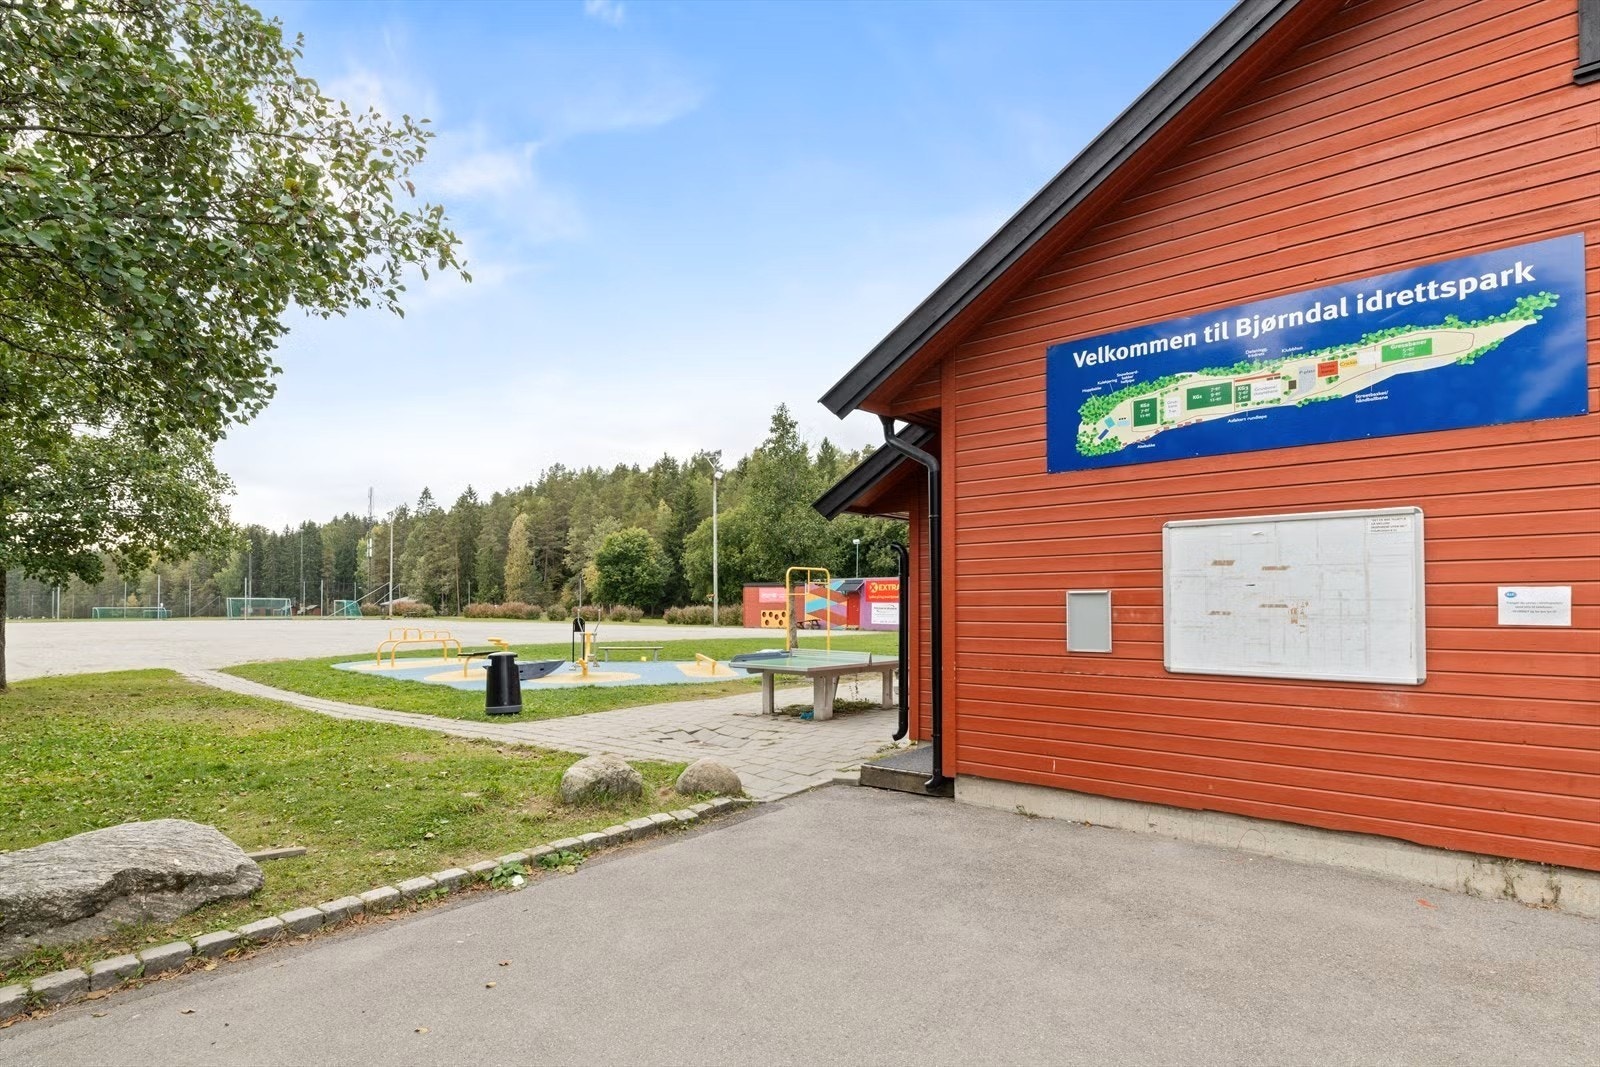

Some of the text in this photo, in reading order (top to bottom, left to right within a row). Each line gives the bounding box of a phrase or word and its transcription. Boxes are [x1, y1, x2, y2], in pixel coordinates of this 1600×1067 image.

[1073, 260, 1536, 368] Velkommen til Bjørndal idrettspark
